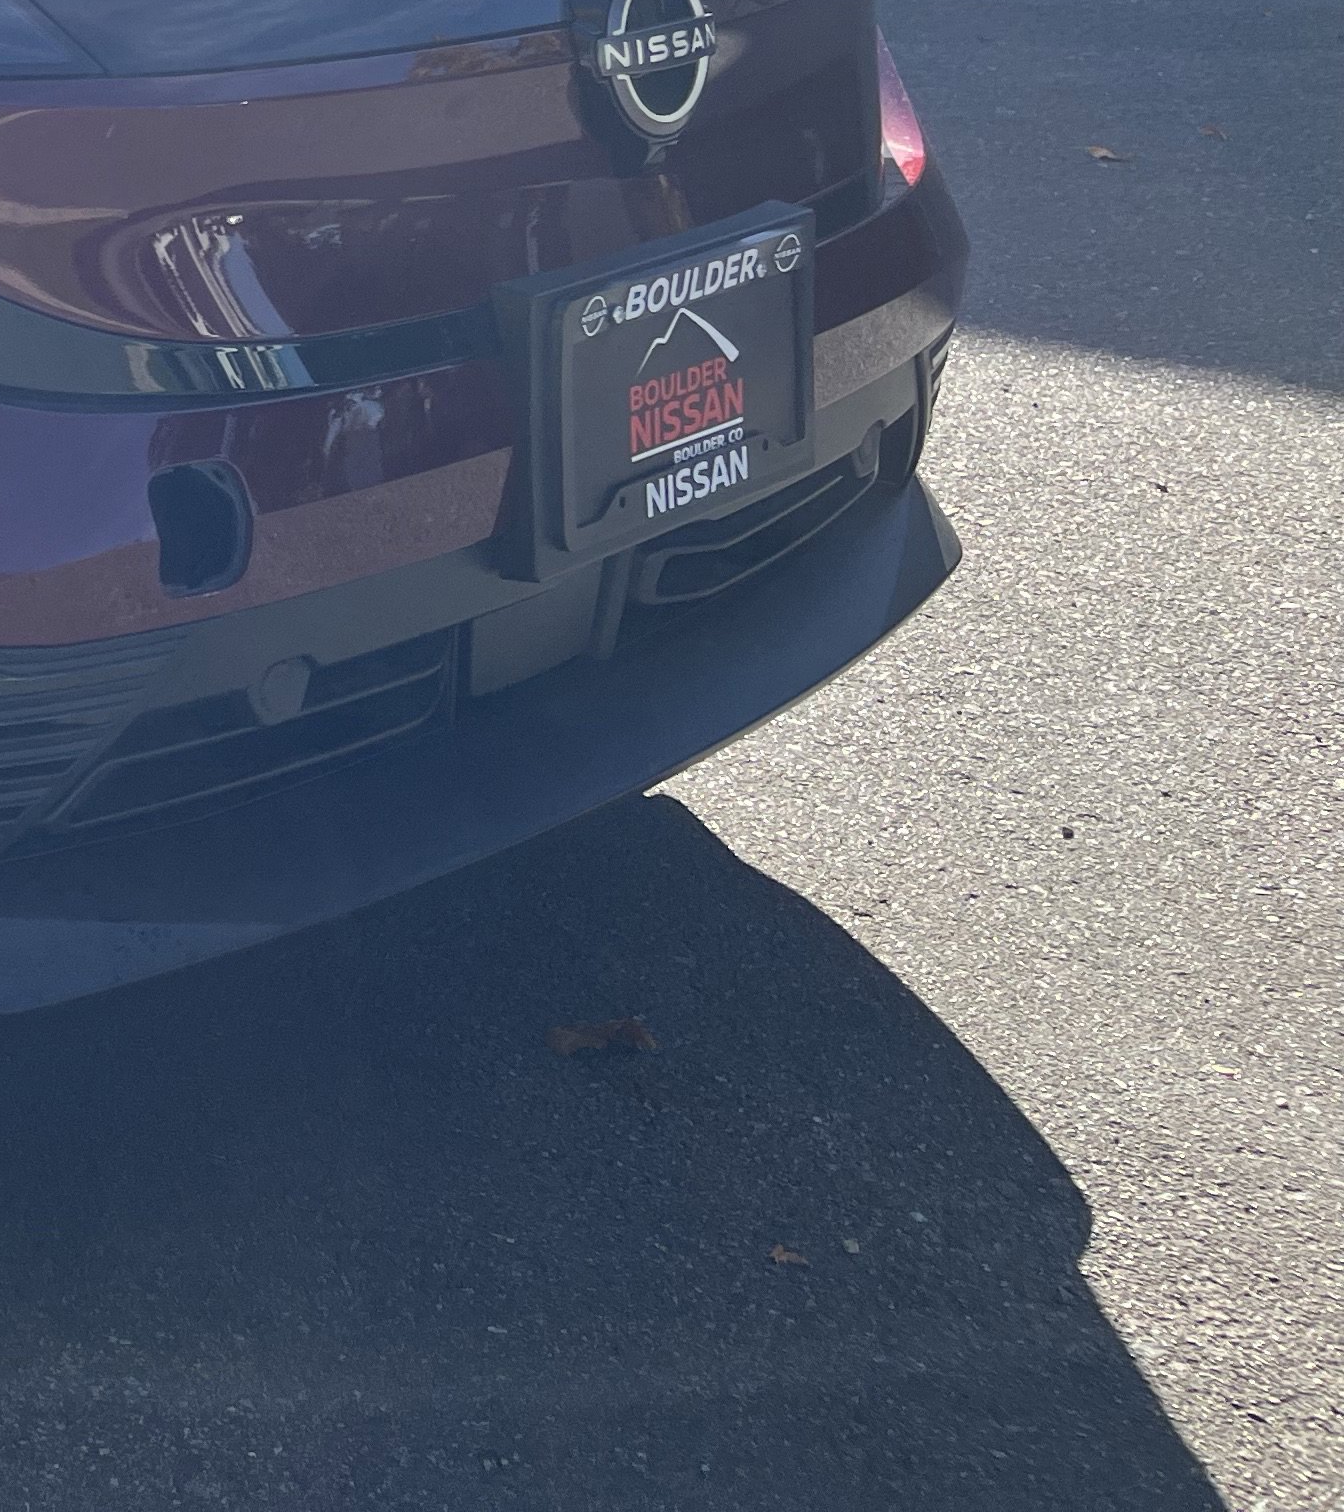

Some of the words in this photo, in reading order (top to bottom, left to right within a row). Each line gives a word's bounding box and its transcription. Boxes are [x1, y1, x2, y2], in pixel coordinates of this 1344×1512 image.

[603, 23, 716, 71] NISSAN
[625, 248, 758, 321] BOULDER
[629, 357, 727, 411] BOULDER
[630, 379, 744, 455] NISSAN
[673, 434, 725, 464] BOULDER
[728, 427, 744, 443] CO
[646, 445, 749, 519] NISSAN
